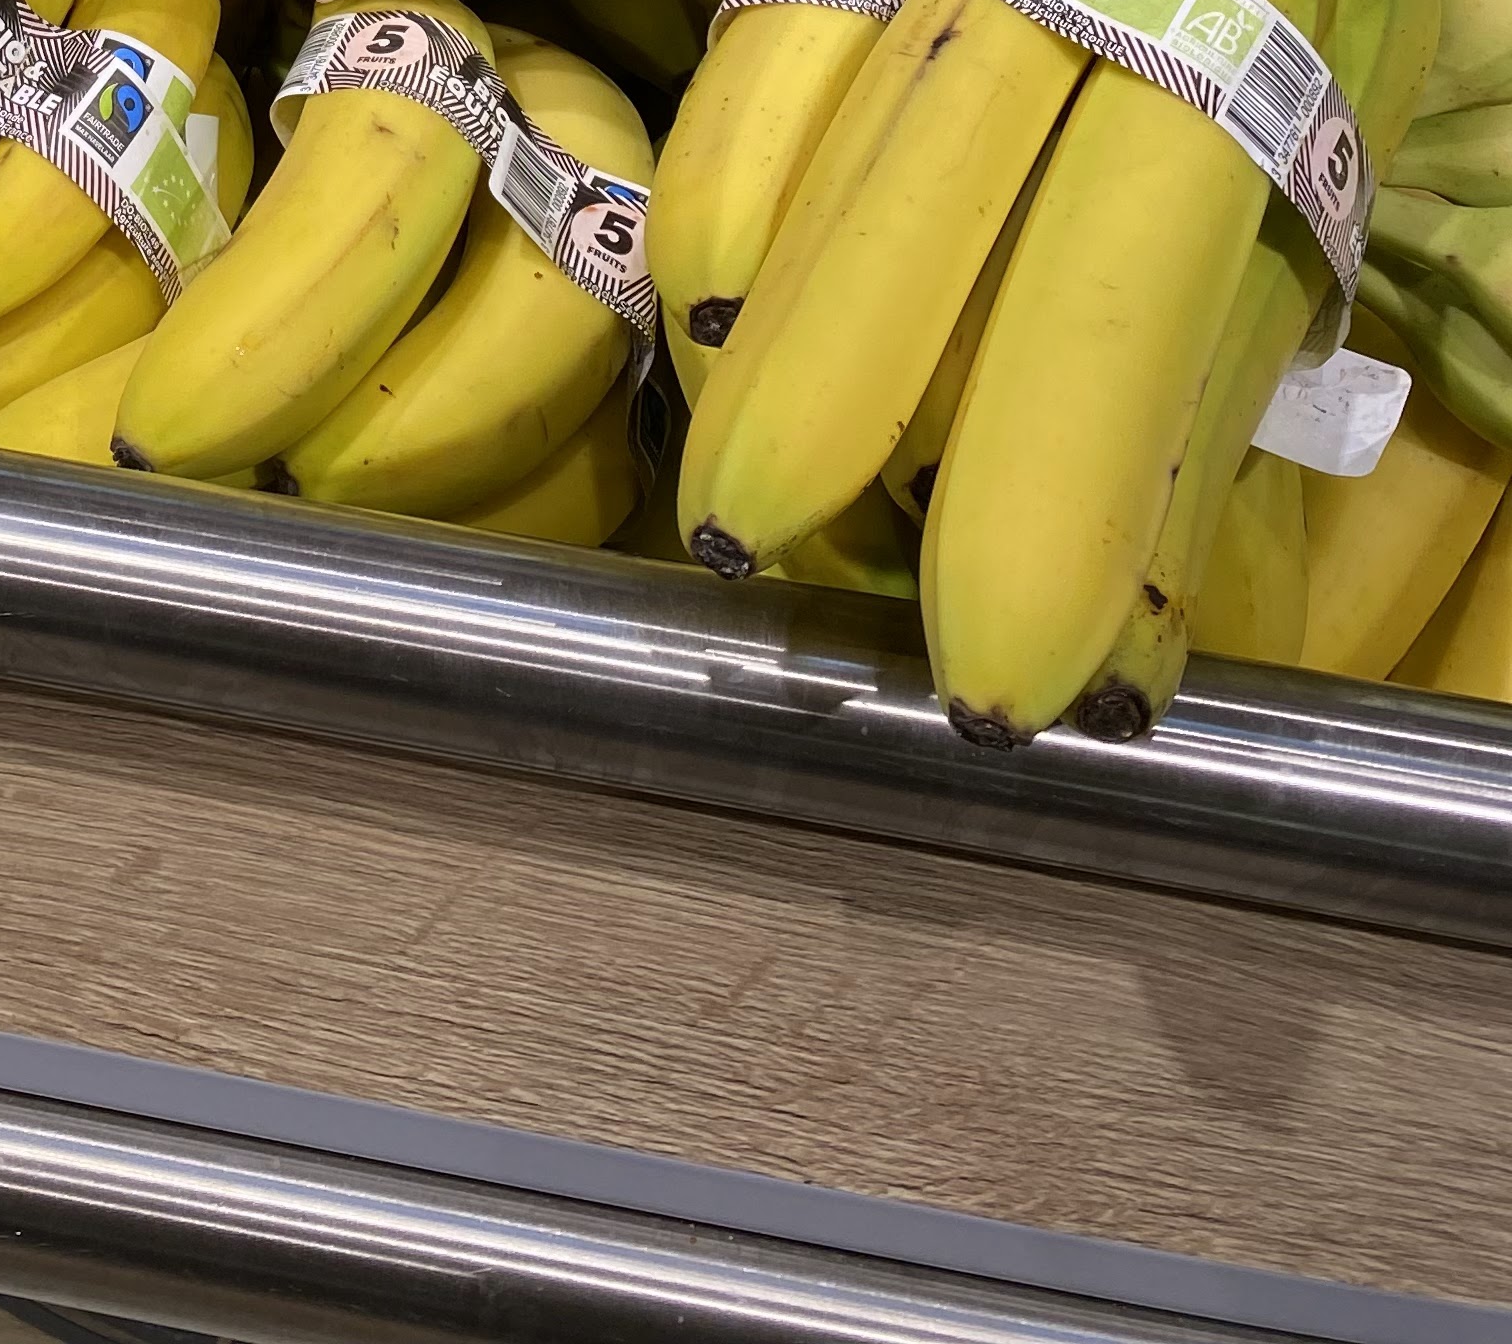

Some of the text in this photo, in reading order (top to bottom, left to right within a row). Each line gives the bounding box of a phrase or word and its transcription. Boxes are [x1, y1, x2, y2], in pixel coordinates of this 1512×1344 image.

[365, 24, 410, 55] 5
[1080, 27, 1105, 48] non
[1106, 41, 1126, 57] UE
[1185, 11, 1243, 56] AB
[23, 61, 48, 82] &
[356, 55, 397, 65] FRUITS
[473, 77, 513, 127] BIO
[1300, 77, 1325, 120] 000892
[82, 111, 126, 153] FAIRTRADE
[1277, 126, 1302, 165] 347761
[1270, 167, 1283, 181] 3
[1327, 129, 1355, 191] 5
[593, 210, 637, 256] 5
[586, 244, 628, 274] FRUITS
